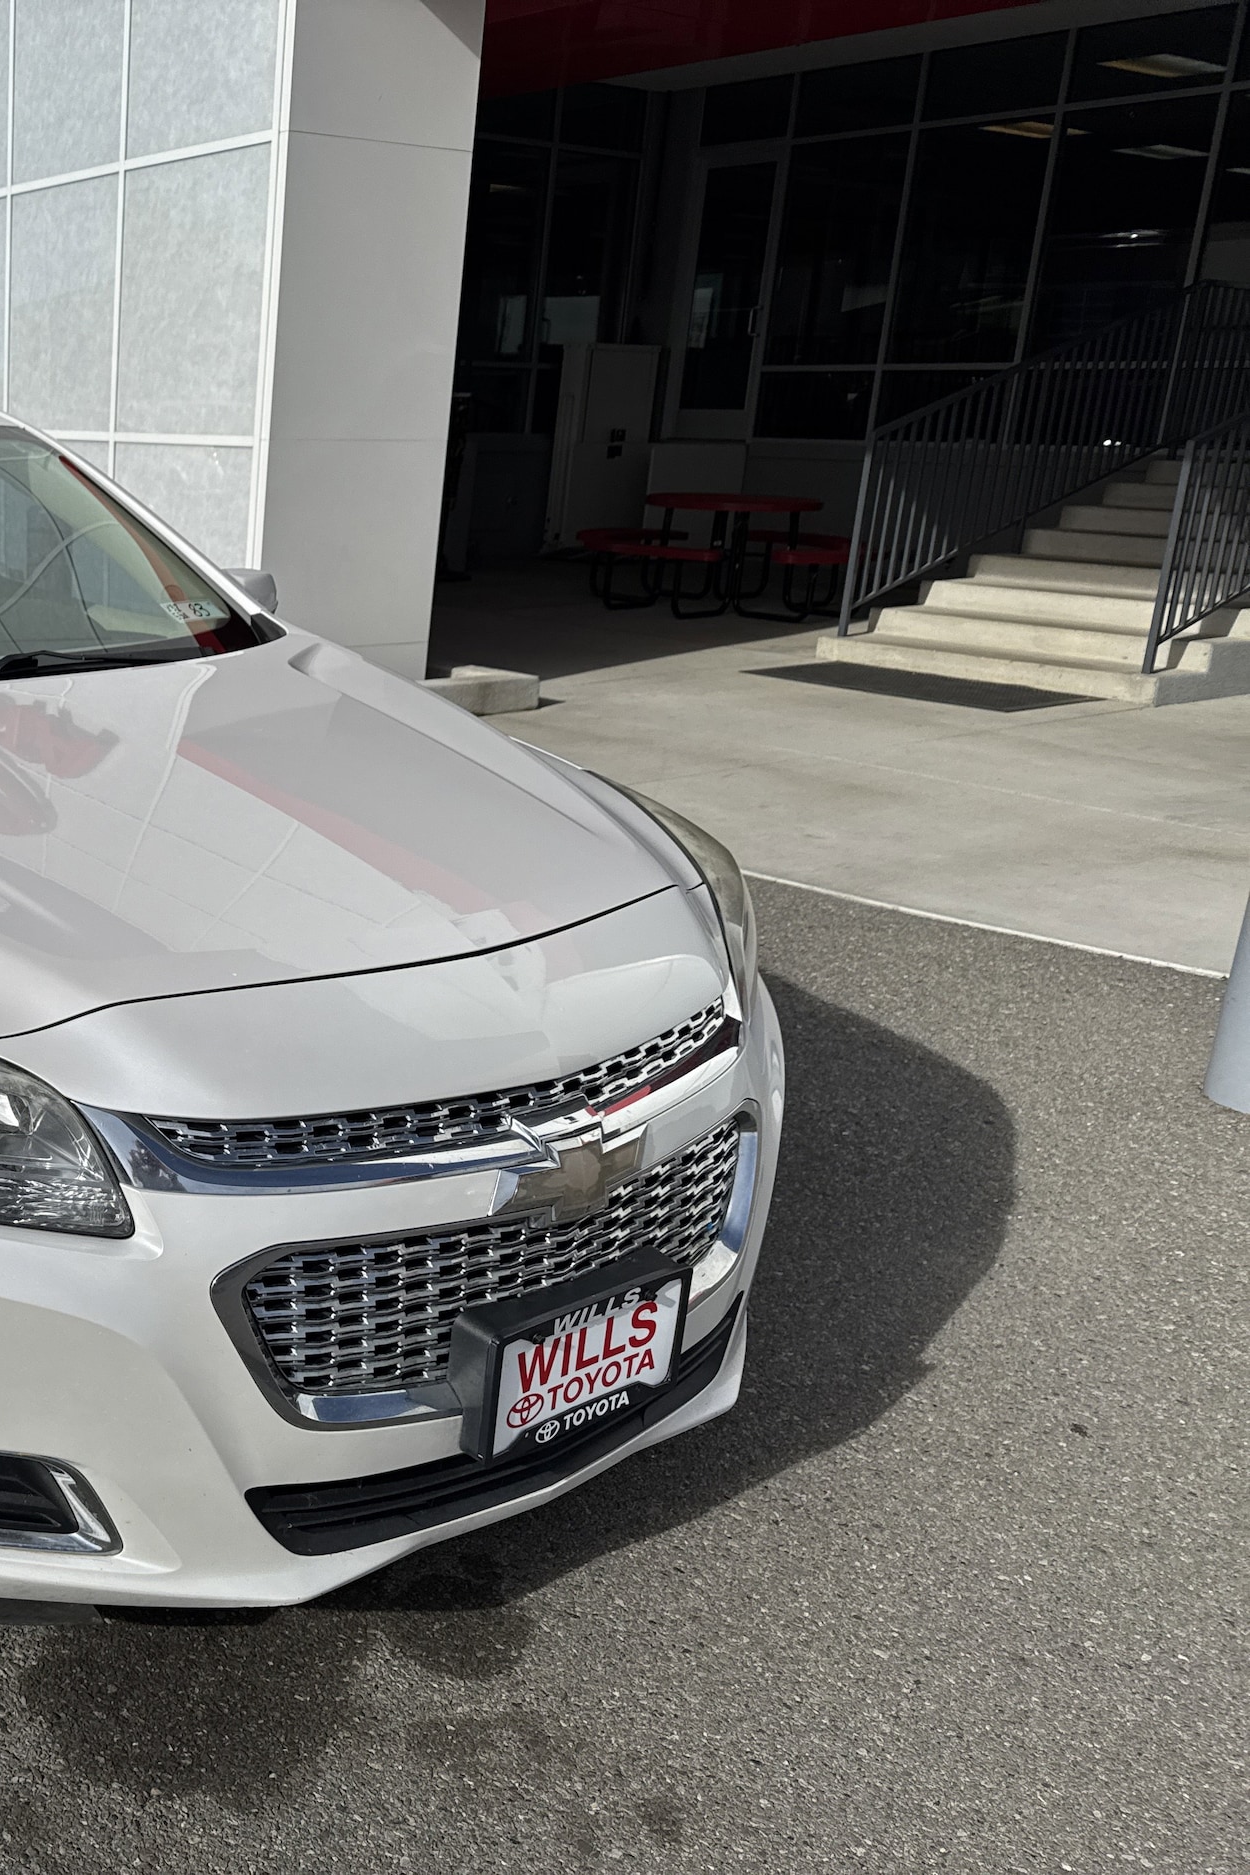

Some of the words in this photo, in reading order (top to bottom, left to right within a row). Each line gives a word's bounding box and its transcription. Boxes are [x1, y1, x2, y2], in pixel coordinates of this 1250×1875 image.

[554, 1287, 641, 1336] WILLS
[517, 1301, 658, 1393] WILLS
[548, 1348, 655, 1411] TOYOTA
[563, 1390, 630, 1431] TOYOTA
